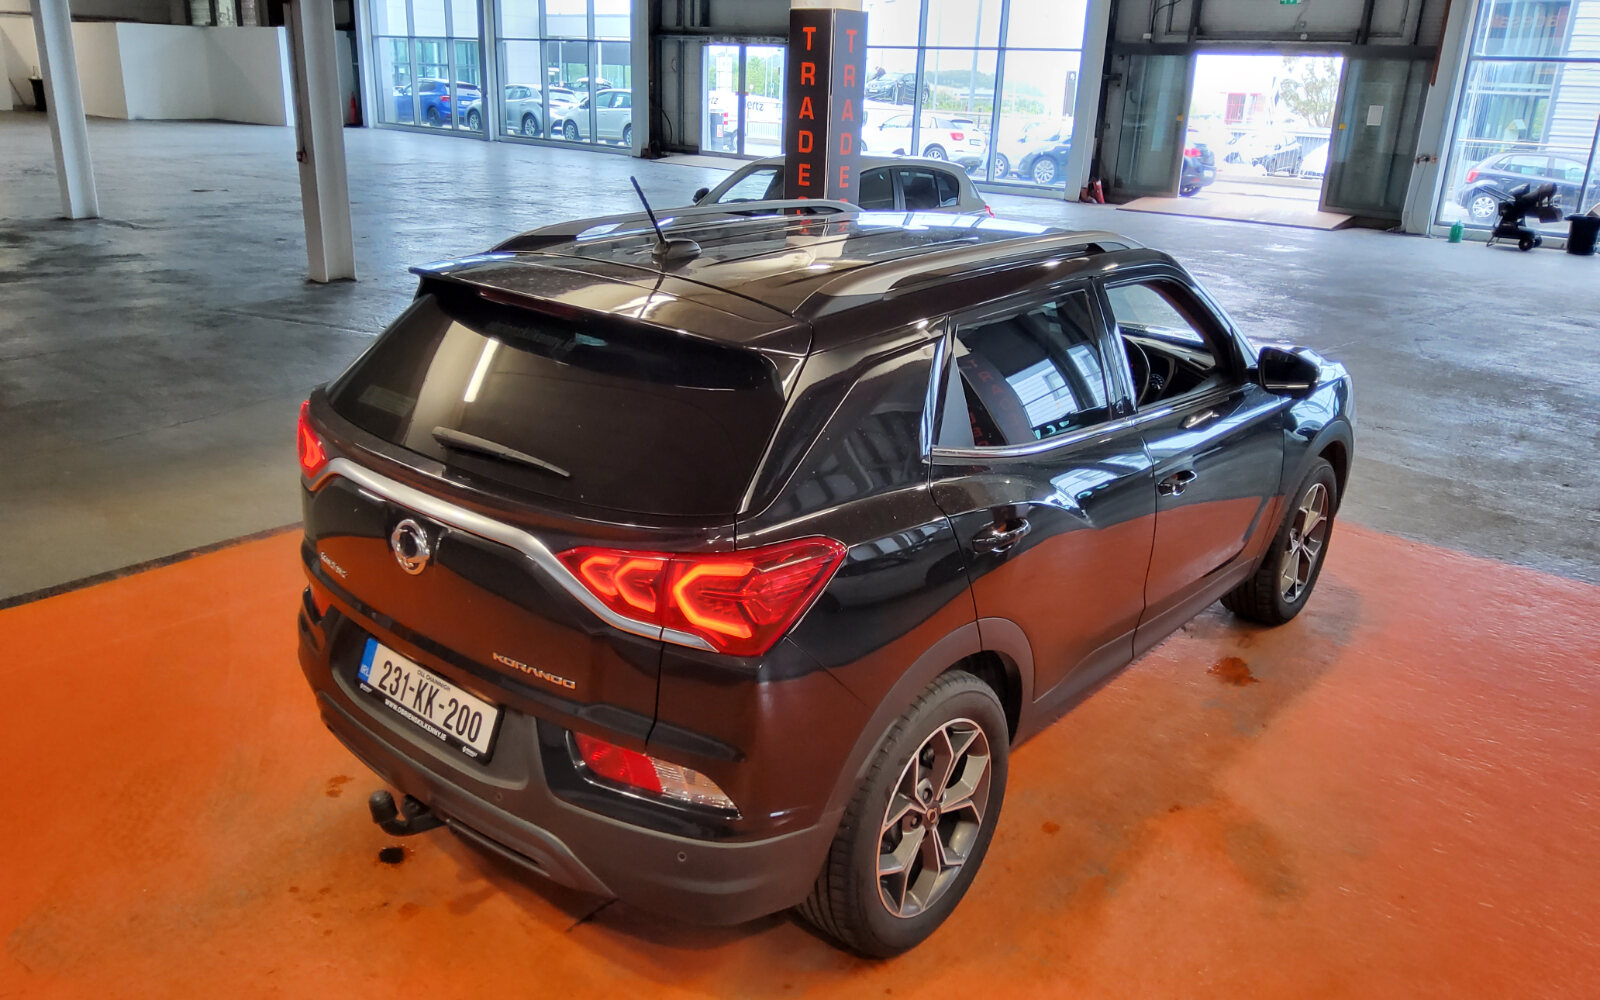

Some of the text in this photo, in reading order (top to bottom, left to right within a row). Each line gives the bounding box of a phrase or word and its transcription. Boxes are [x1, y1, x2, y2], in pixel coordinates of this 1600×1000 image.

[797, 27, 816, 200] TRADE
[839, 30, 857, 203] TRADE
[378, 660, 482, 743] 231-KK-200
[492, 652, 576, 689] KORANDO
